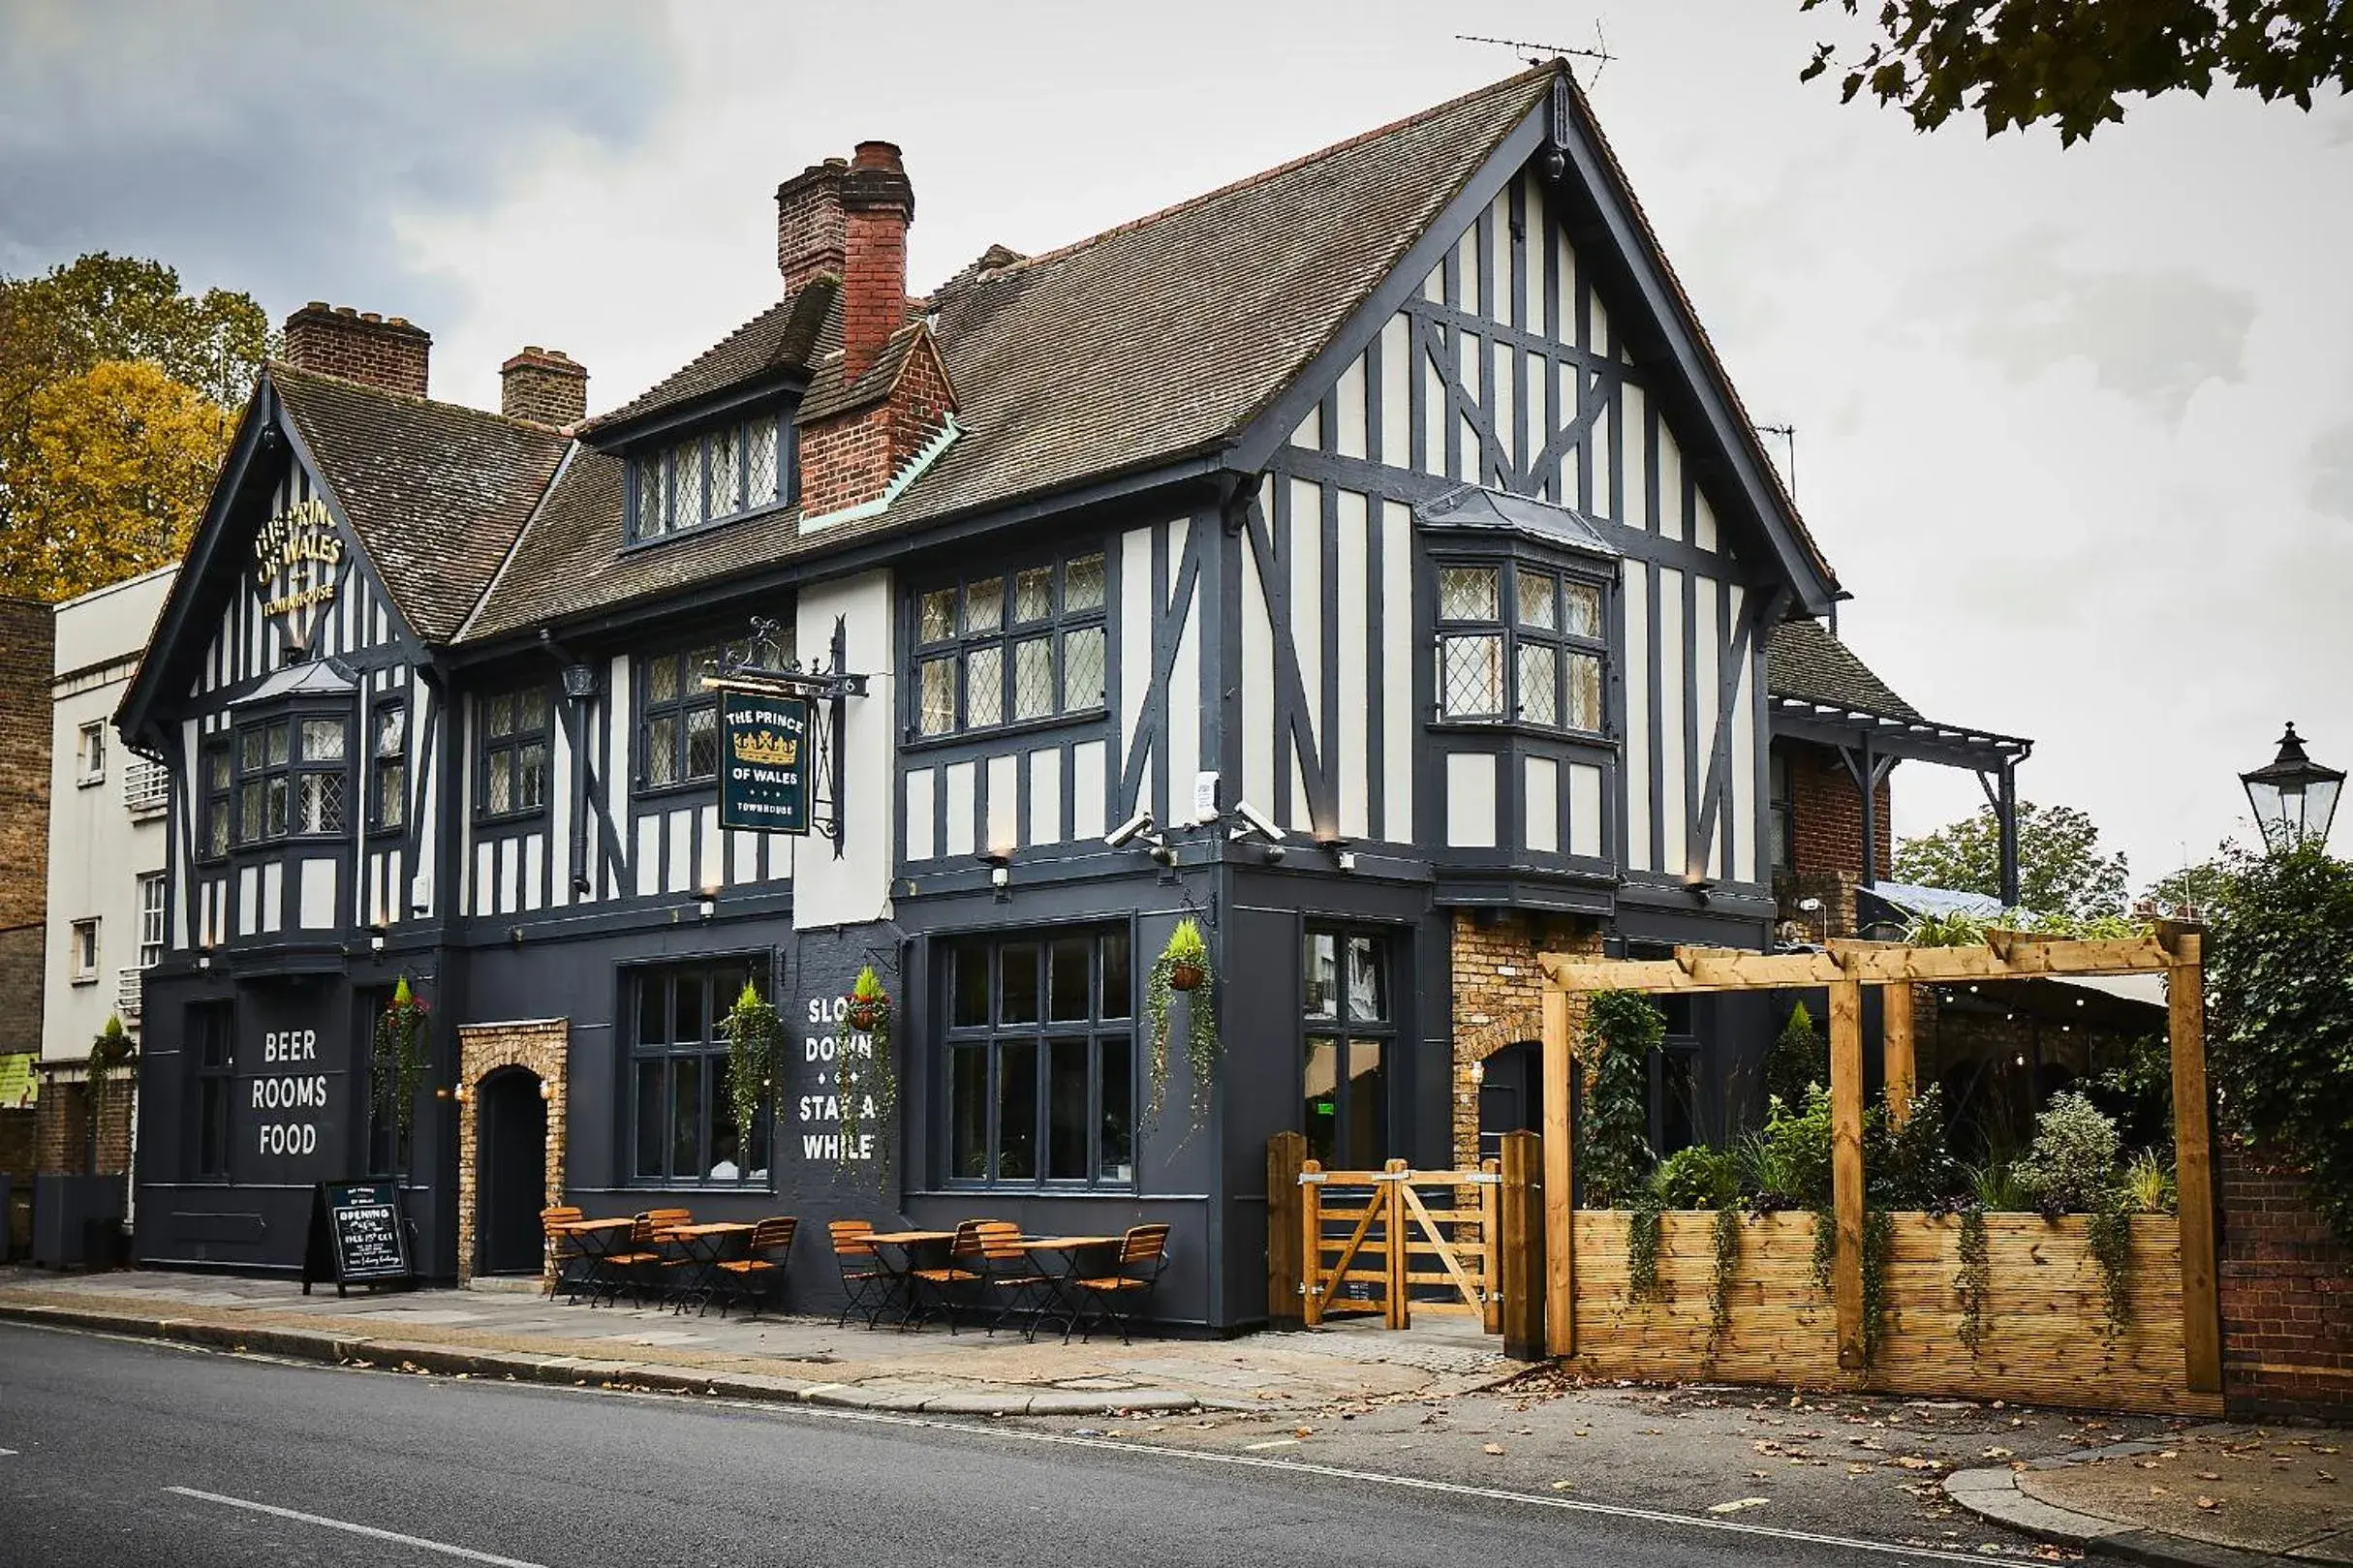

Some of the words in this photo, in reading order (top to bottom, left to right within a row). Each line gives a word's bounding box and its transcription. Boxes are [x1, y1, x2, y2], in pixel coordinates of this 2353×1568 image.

[282, 534, 343, 566] WALES
[263, 584, 334, 618] TOWNHOUSE
[727, 710, 754, 725] THE
[755, 710, 805, 735] PRINCE
[732, 767, 751, 781] OF
[754, 768, 798, 785] WALES
[736, 801, 792, 815] TOWNHOUSE
[808, 996, 856, 1024] SLO
[264, 1030, 317, 1062] BEER
[252, 1075, 327, 1109] ROOMS
[859, 1094, 877, 1120] A
[260, 1123, 317, 1155] FOOD
[802, 1134, 874, 1160] WHILE
